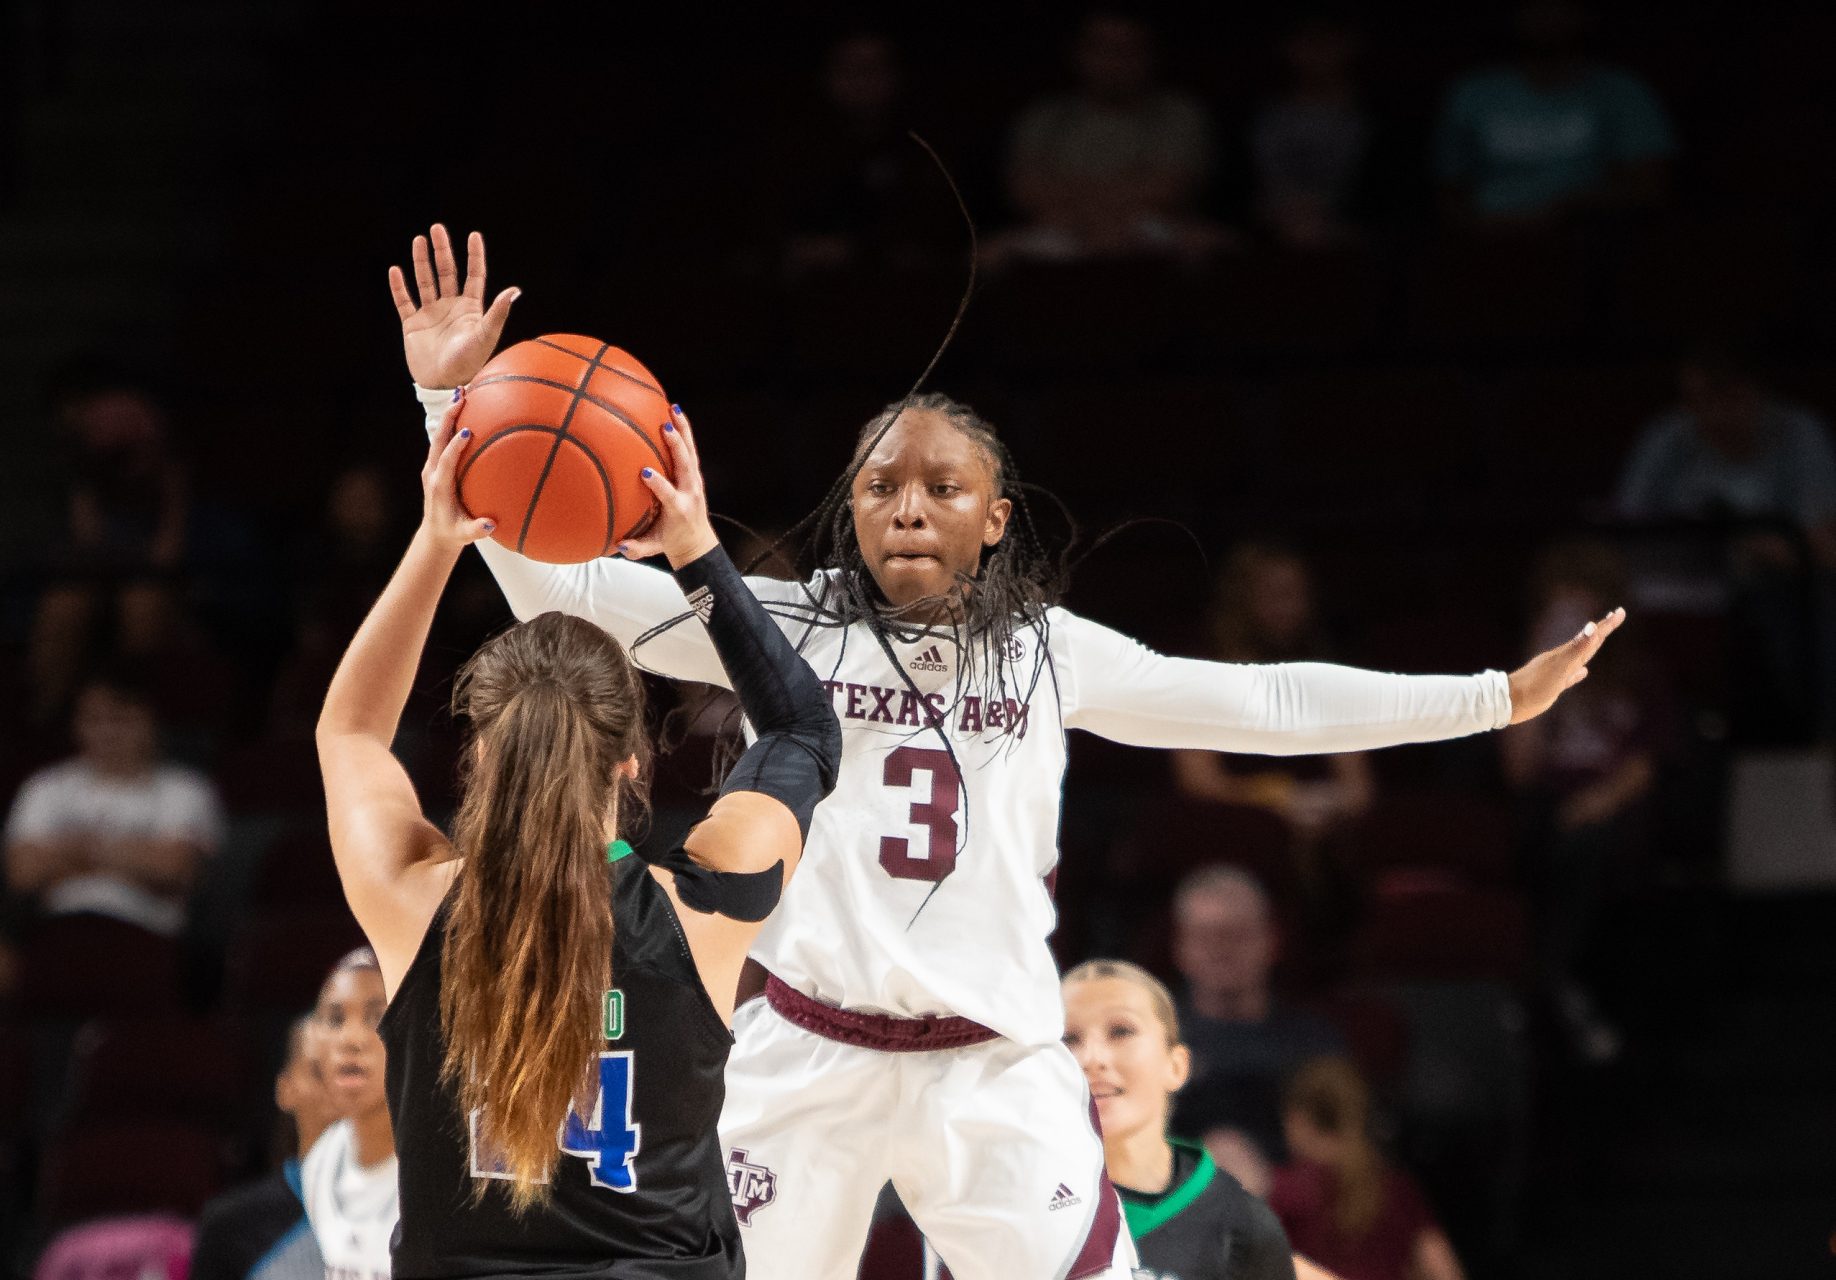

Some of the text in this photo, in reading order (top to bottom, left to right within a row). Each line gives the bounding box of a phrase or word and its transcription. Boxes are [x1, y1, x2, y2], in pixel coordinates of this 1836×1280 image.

[909, 660, 949, 673] adidas
[821, 680, 1030, 740] TEXAS A&M
[878, 745, 960, 882] 3
